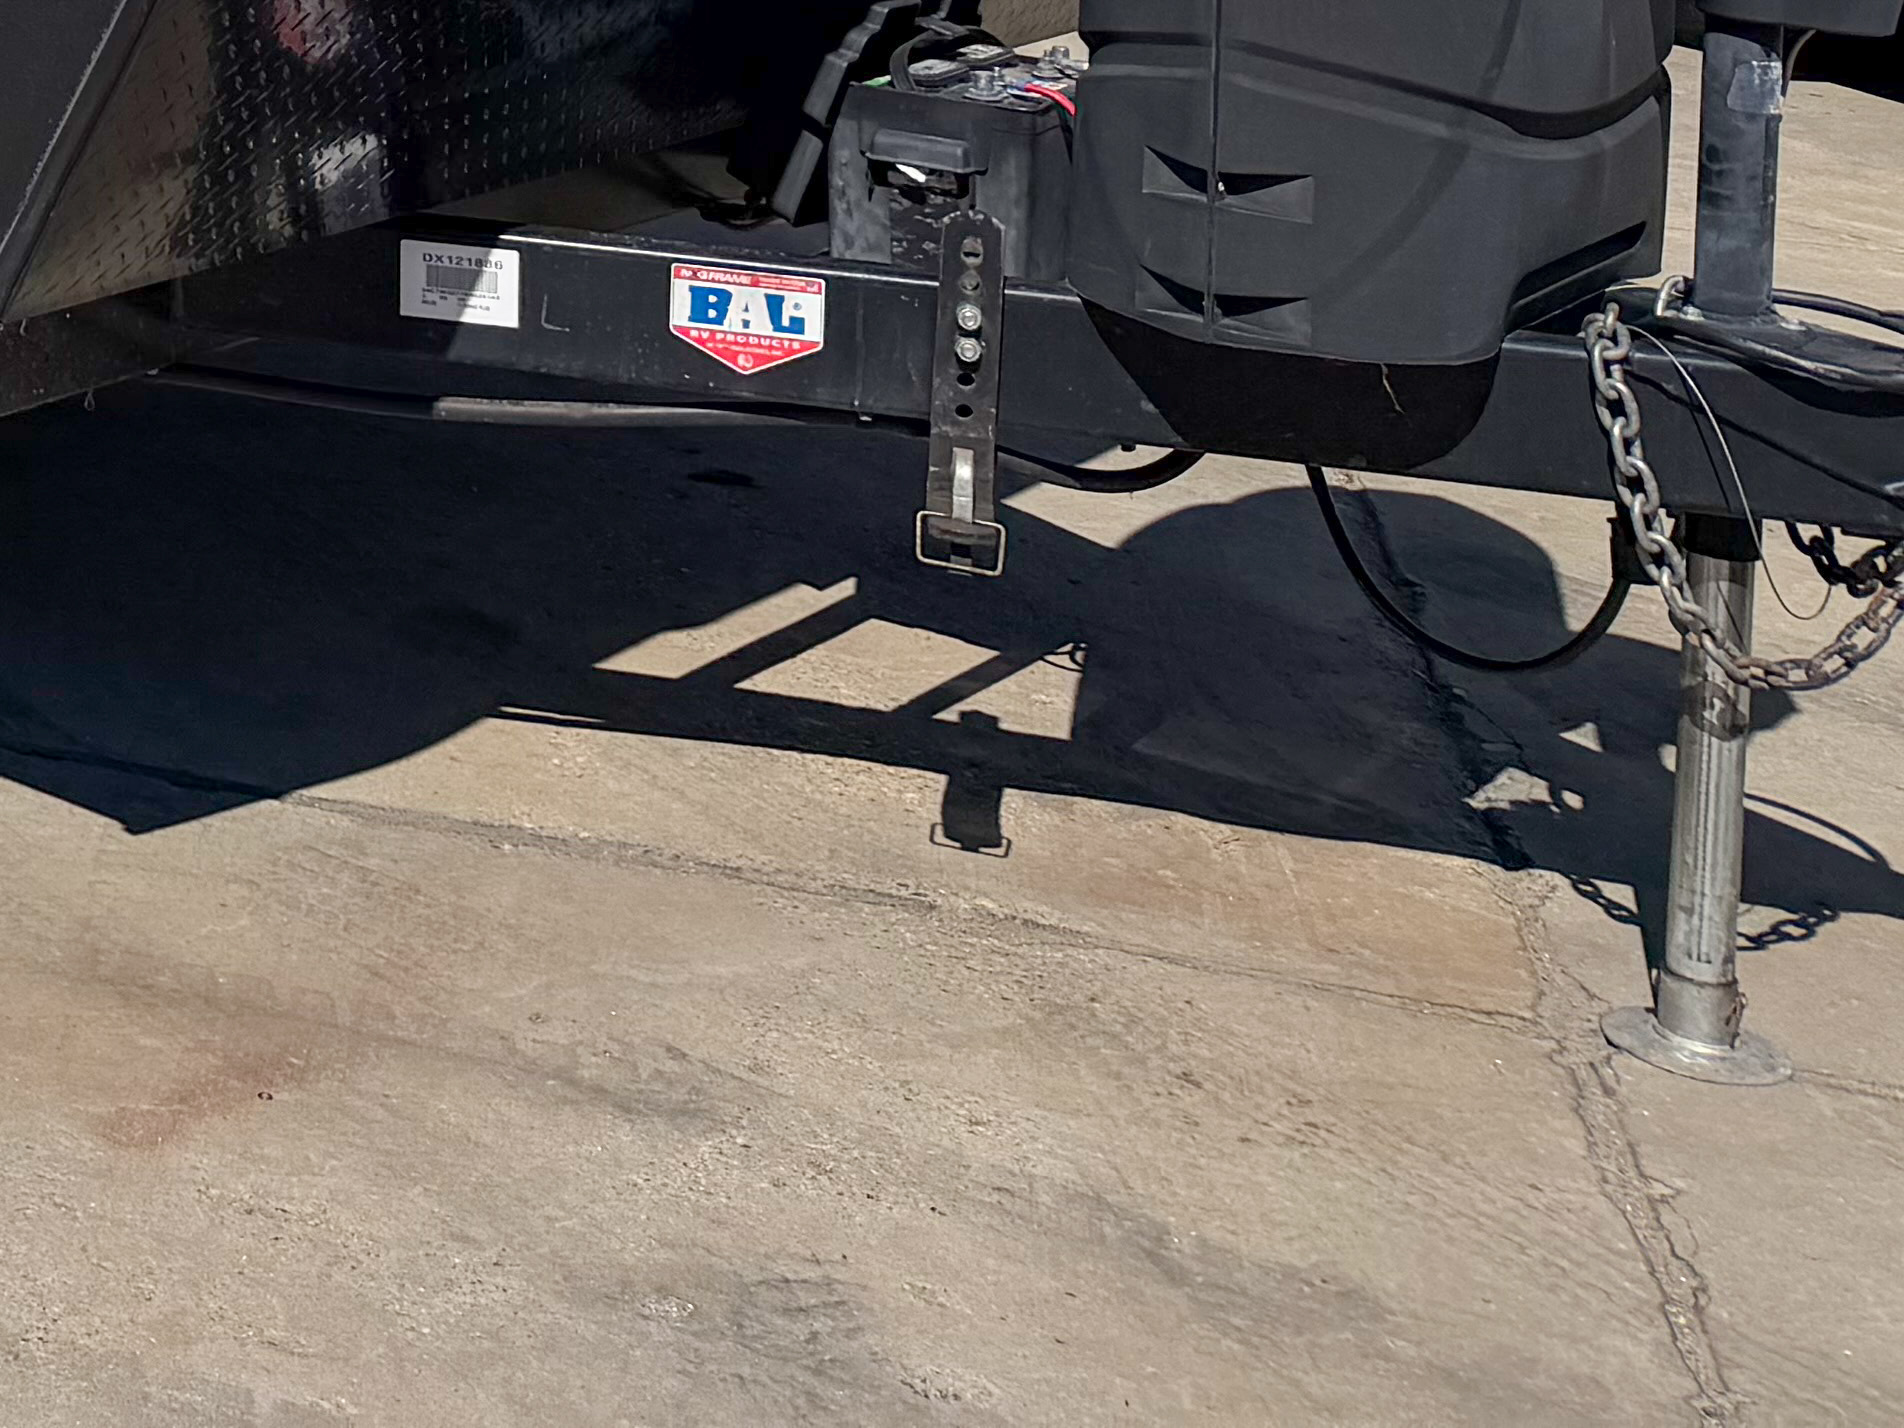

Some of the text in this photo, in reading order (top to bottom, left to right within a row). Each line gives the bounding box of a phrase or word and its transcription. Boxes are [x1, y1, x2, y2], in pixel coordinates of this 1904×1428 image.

[688, 285, 806, 335] BAL
[689, 329, 710, 339] RV
[715, 332, 801, 349] PRODUCTS
